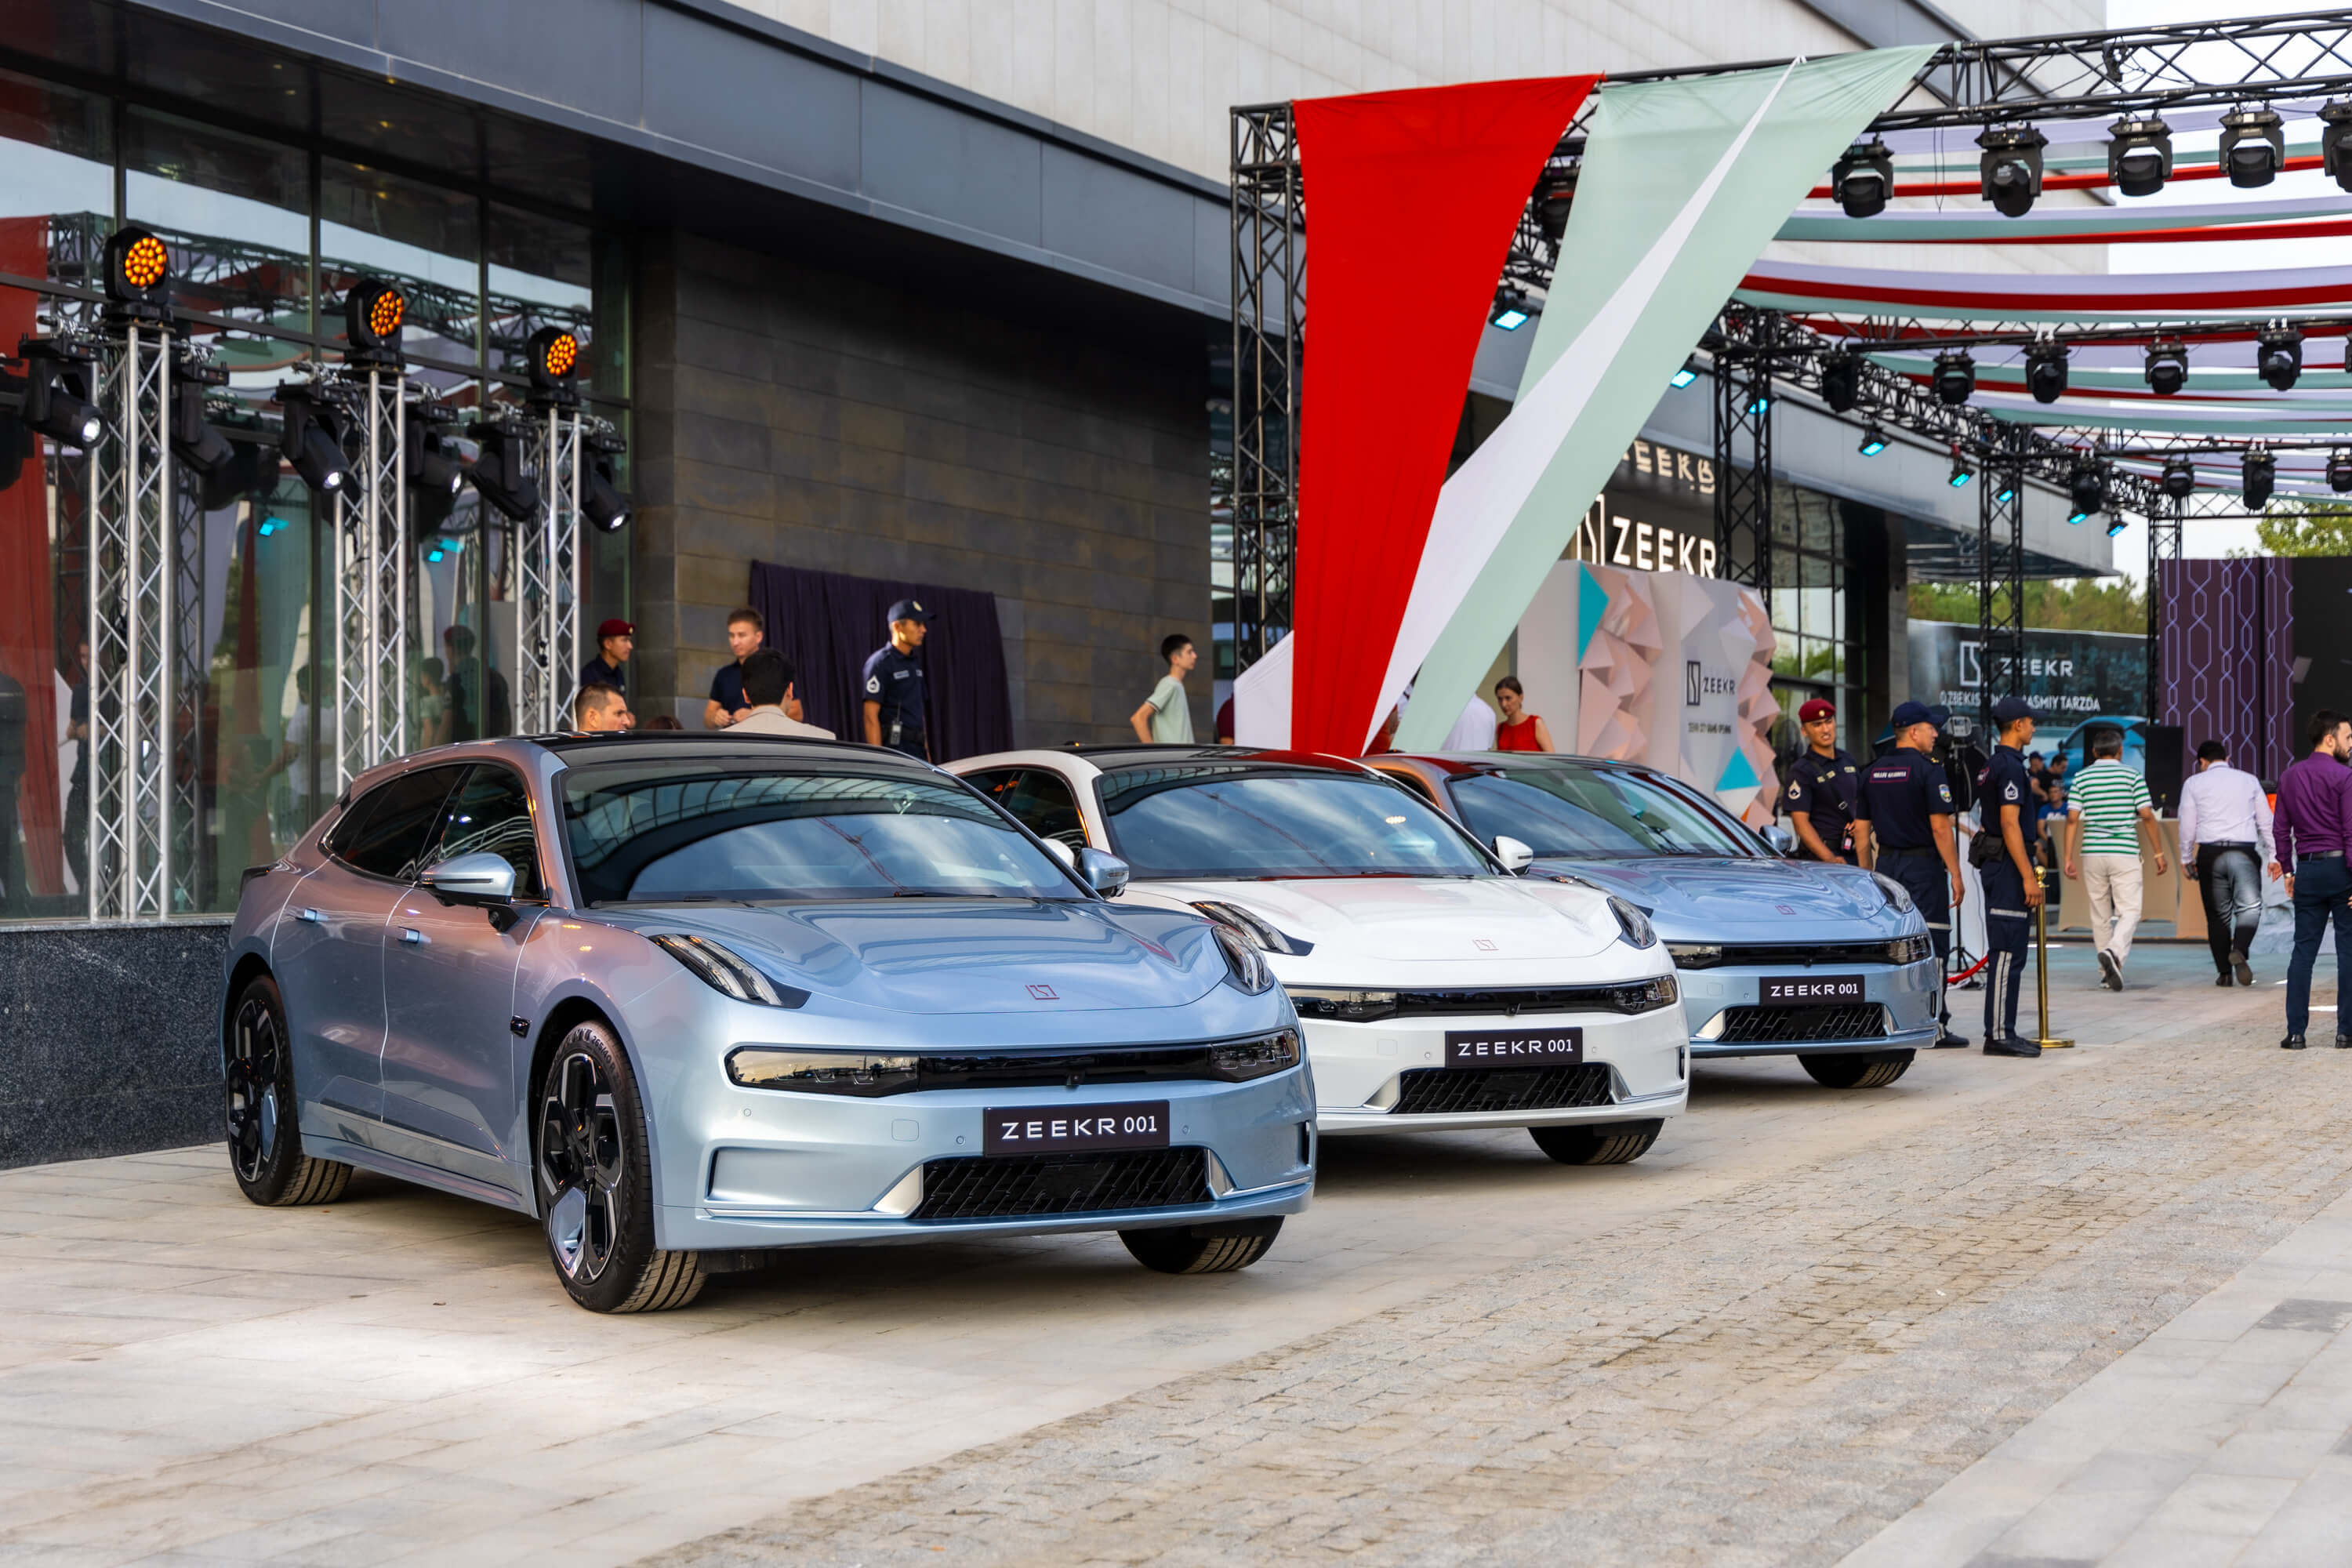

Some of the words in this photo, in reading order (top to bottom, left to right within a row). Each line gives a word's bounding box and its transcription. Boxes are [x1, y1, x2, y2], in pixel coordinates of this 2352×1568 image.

[1612, 515, 1716, 579] ZEEKR
[1703, 677, 1736, 695] ZEEKR
[2060, 695, 2101, 712] TARZDA
[1770, 984, 1835, 997] ZEEKR
[1838, 983, 1859, 995] 001
[1457, 1040, 1542, 1057] ZEEKR
[1548, 1039, 1573, 1053] 001
[1001, 1117, 1116, 1140] ZEEKR
[1123, 1115, 1157, 1134] 001
